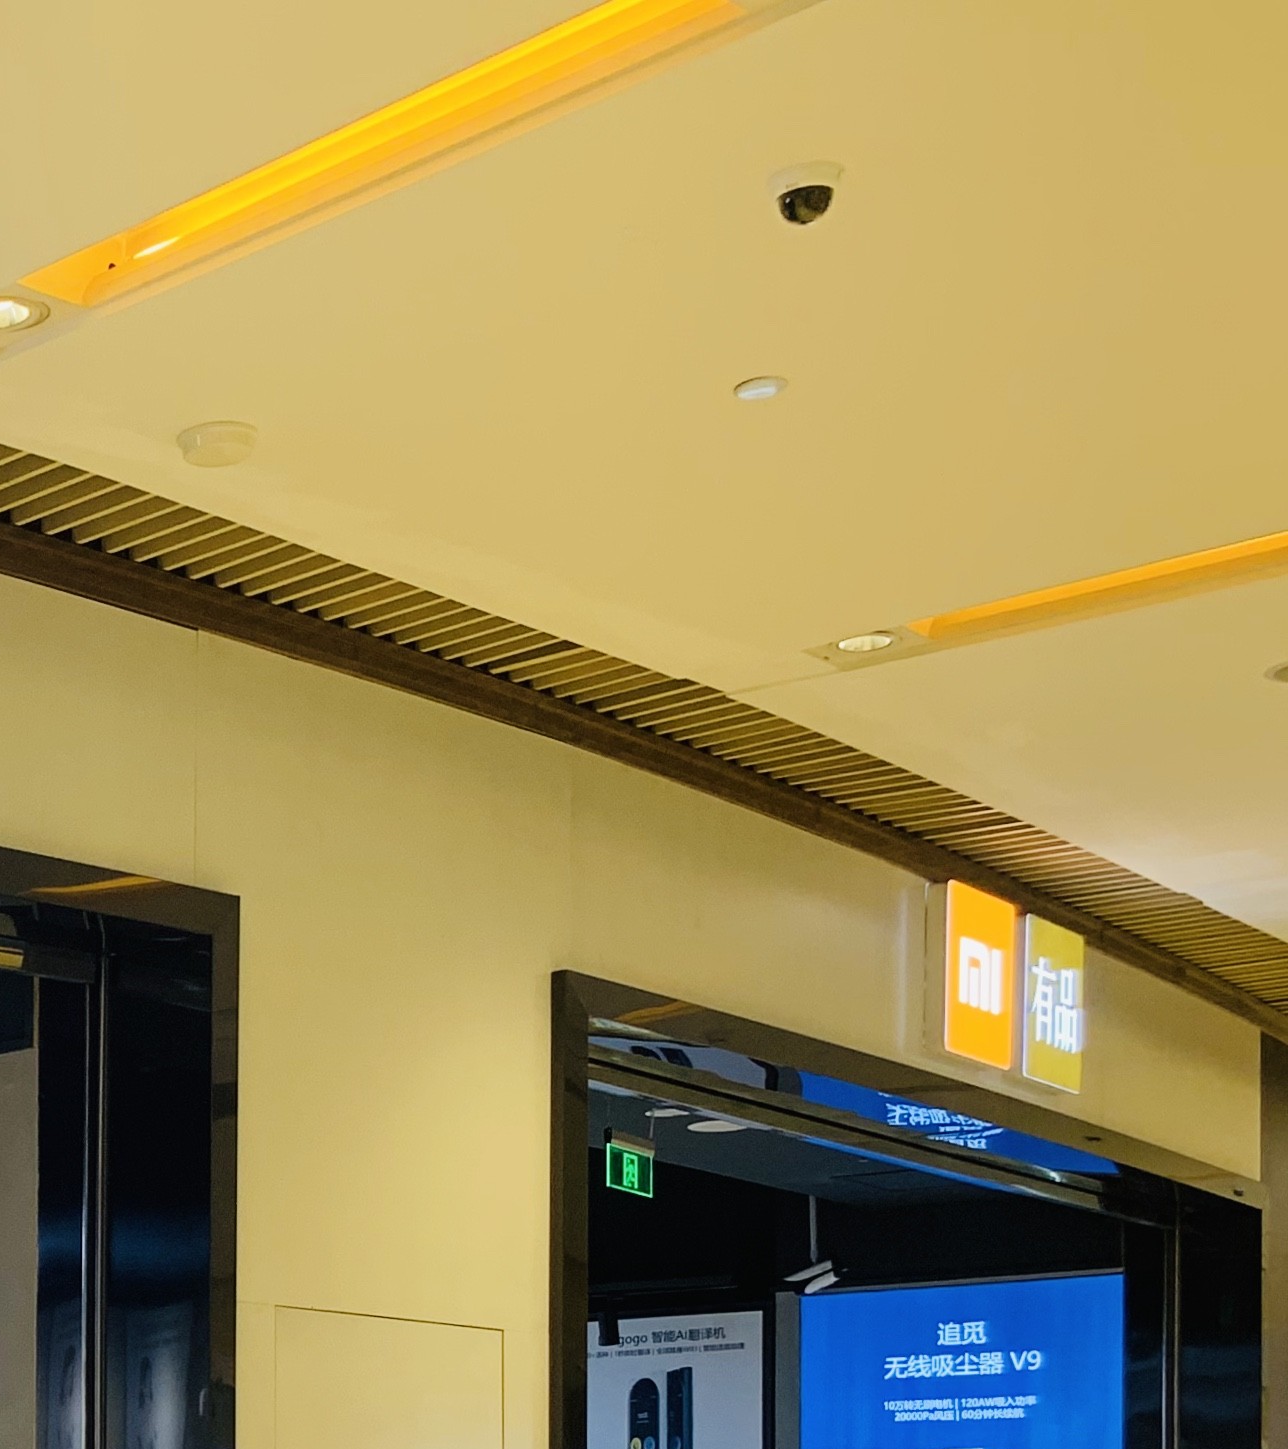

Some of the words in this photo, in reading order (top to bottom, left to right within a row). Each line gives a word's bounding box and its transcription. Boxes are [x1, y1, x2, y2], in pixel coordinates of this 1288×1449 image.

[1029, 956, 1082, 1055] 有品
[936, 1321, 987, 1346] 追觅
[883, 1351, 1004, 1380] 无线吸尘器
[1009, 1349, 1042, 1371] V9
